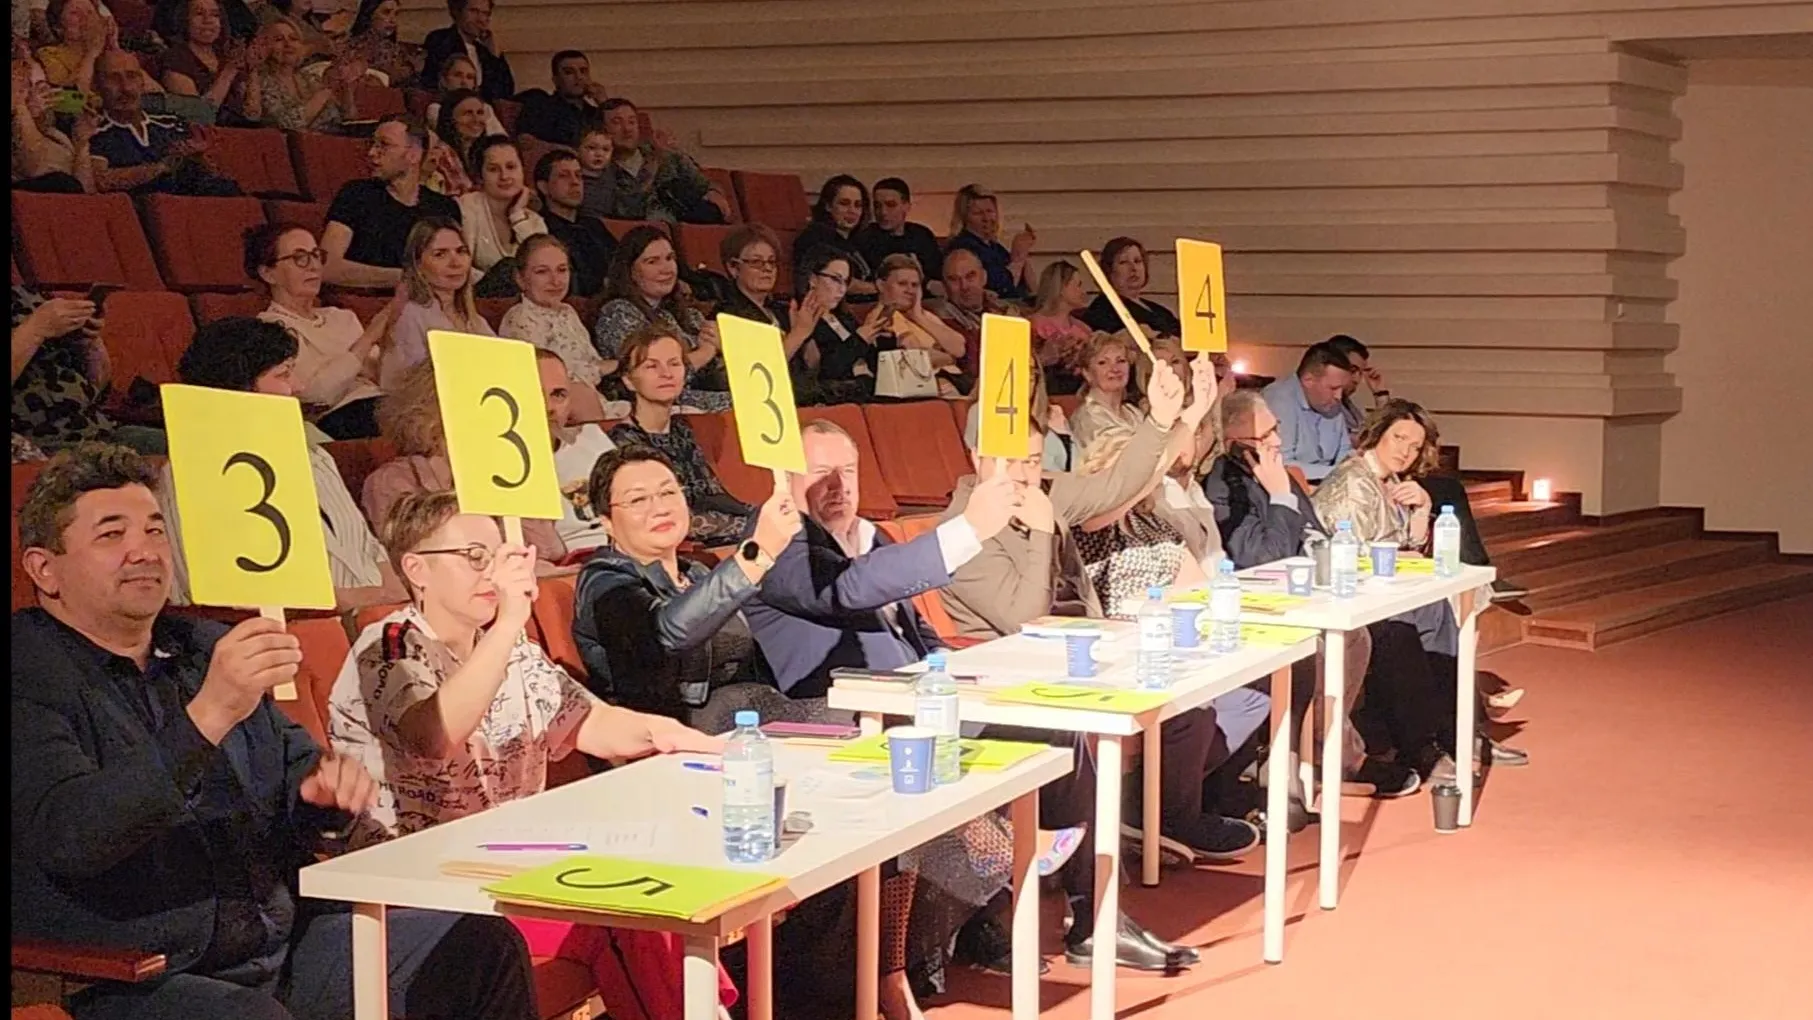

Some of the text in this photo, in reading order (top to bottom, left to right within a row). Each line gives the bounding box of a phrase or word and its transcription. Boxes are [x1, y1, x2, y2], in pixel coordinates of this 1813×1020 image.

[1195, 274, 1217, 334] 4
[748, 362, 785, 445] 3
[995, 358, 1019, 435] 4
[480, 387, 531, 489] 3
[222, 451, 291, 573] 3
[555, 867, 674, 897] 5
